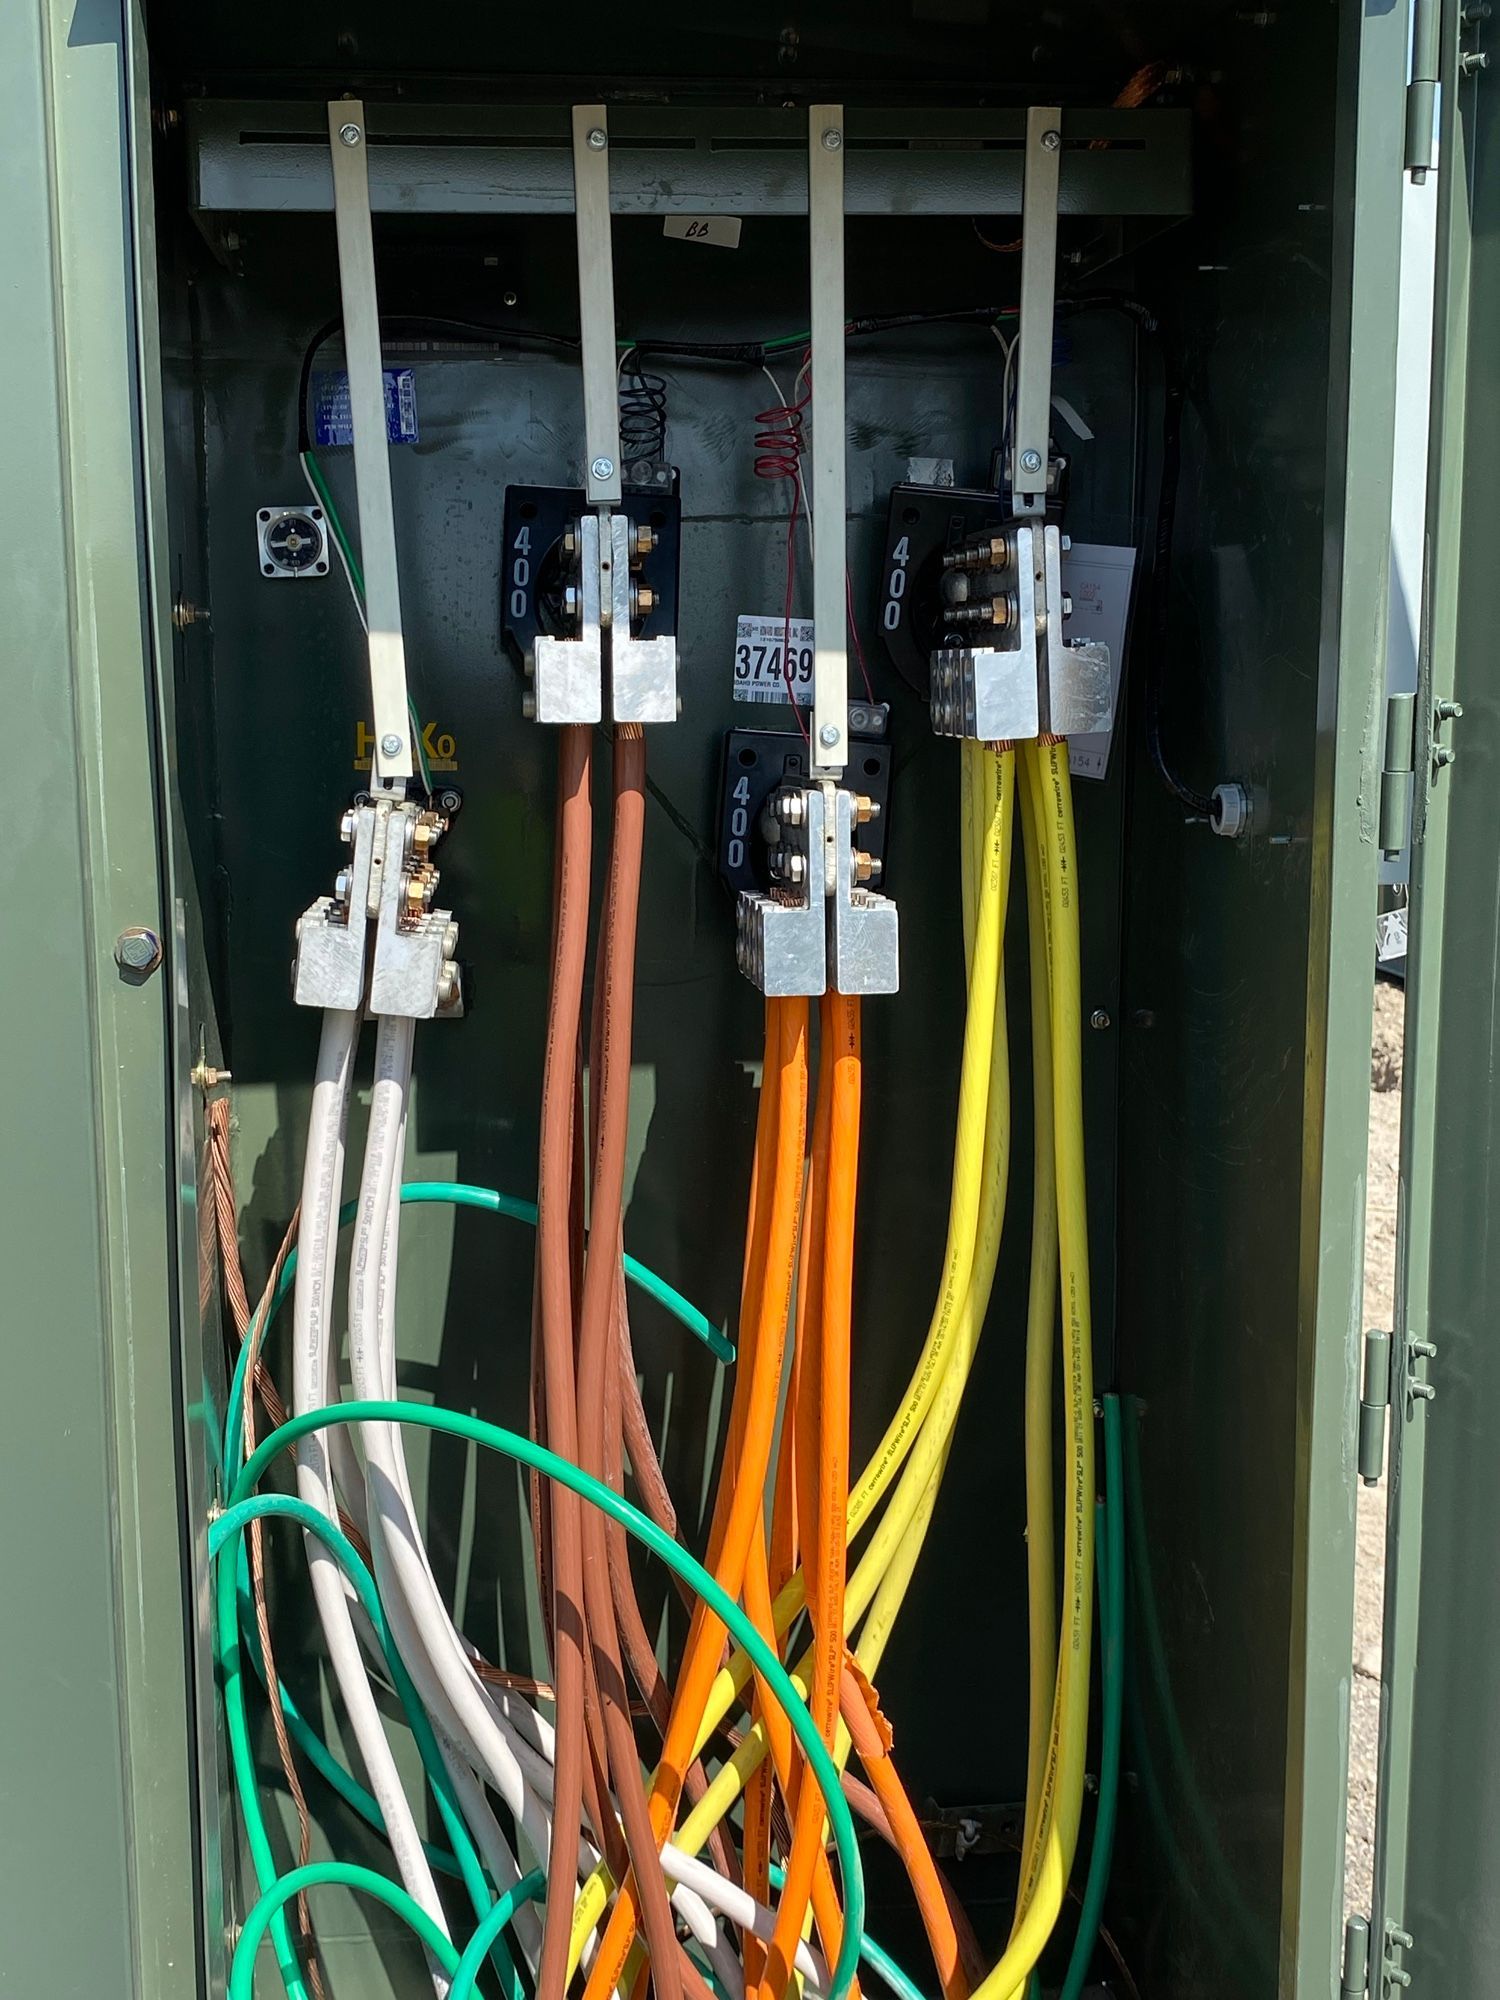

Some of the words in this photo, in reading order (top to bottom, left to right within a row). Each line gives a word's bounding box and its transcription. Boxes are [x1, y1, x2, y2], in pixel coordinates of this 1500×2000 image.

[685, 221, 709, 237] BB
[510, 526, 532, 618] 400
[884, 536, 909, 631] 400
[735, 644, 813, 683] 37469
[728, 776, 750, 868] 400
[1057, 821, 1064, 830] FT
[1061, 876, 1069, 885] FT
[1075, 1560, 1082, 1569] FT
[1073, 1616, 1080, 1625] FT
[830, 1631, 838, 1642] 500
